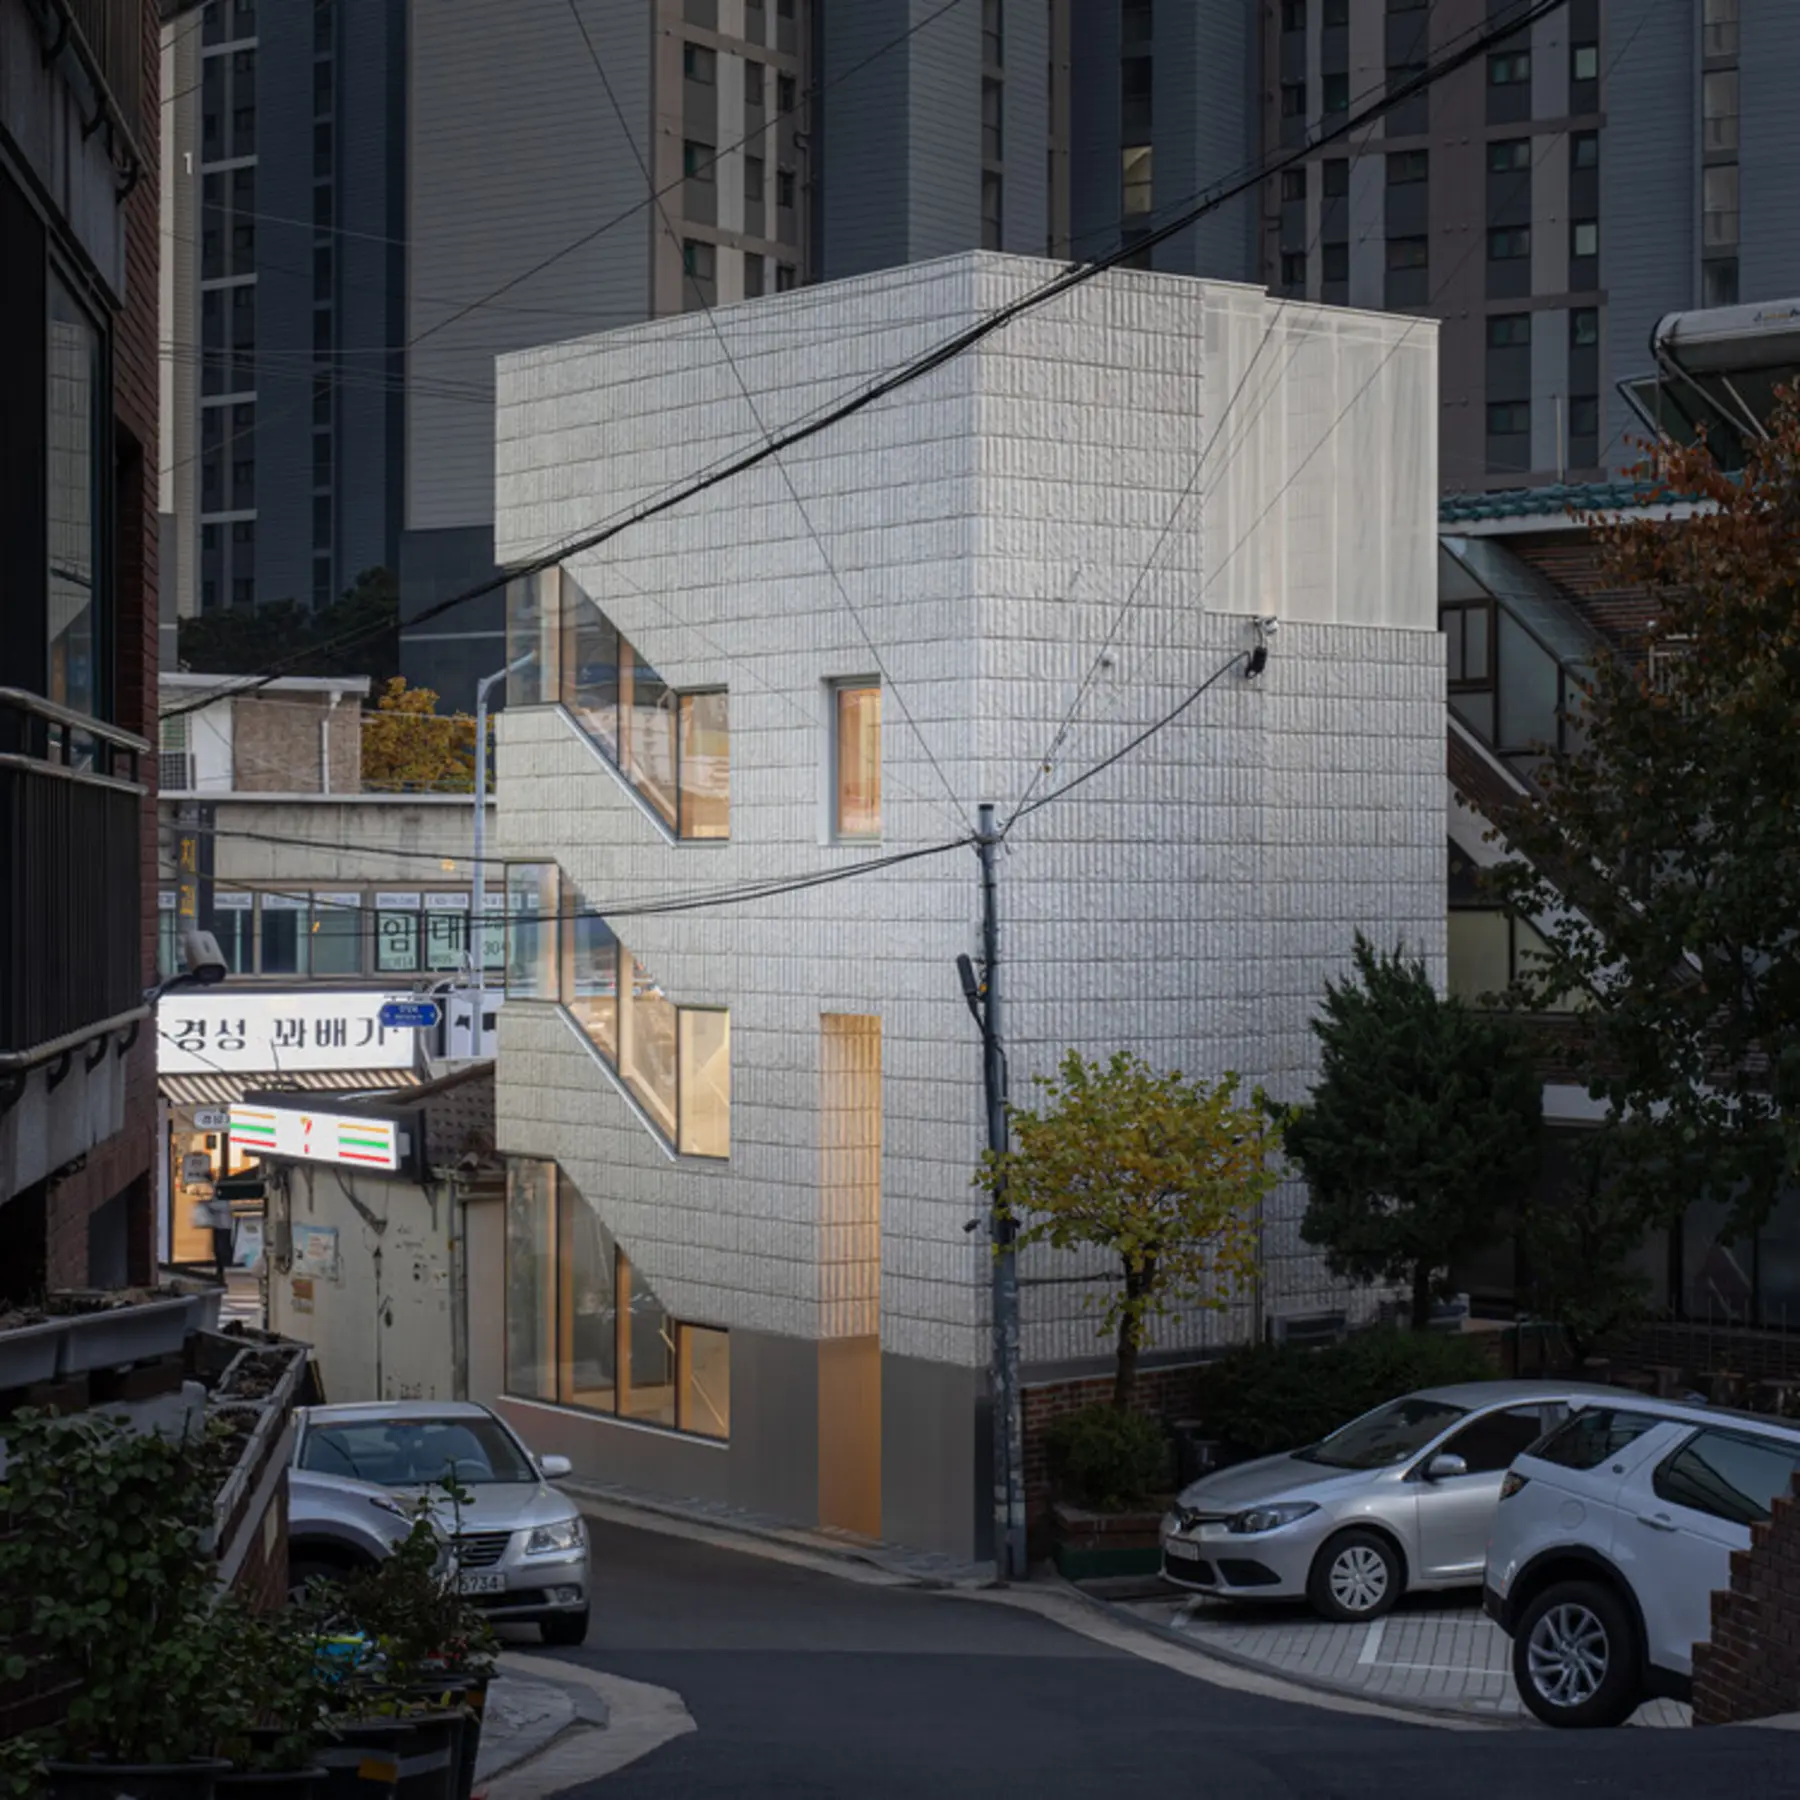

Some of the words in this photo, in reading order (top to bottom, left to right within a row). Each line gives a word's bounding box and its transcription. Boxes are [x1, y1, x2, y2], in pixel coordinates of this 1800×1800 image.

[174, 1018, 247, 1051] 경성
[272, 1017, 386, 1049] 꽈배기
[300, 1116, 313, 1154] 7
